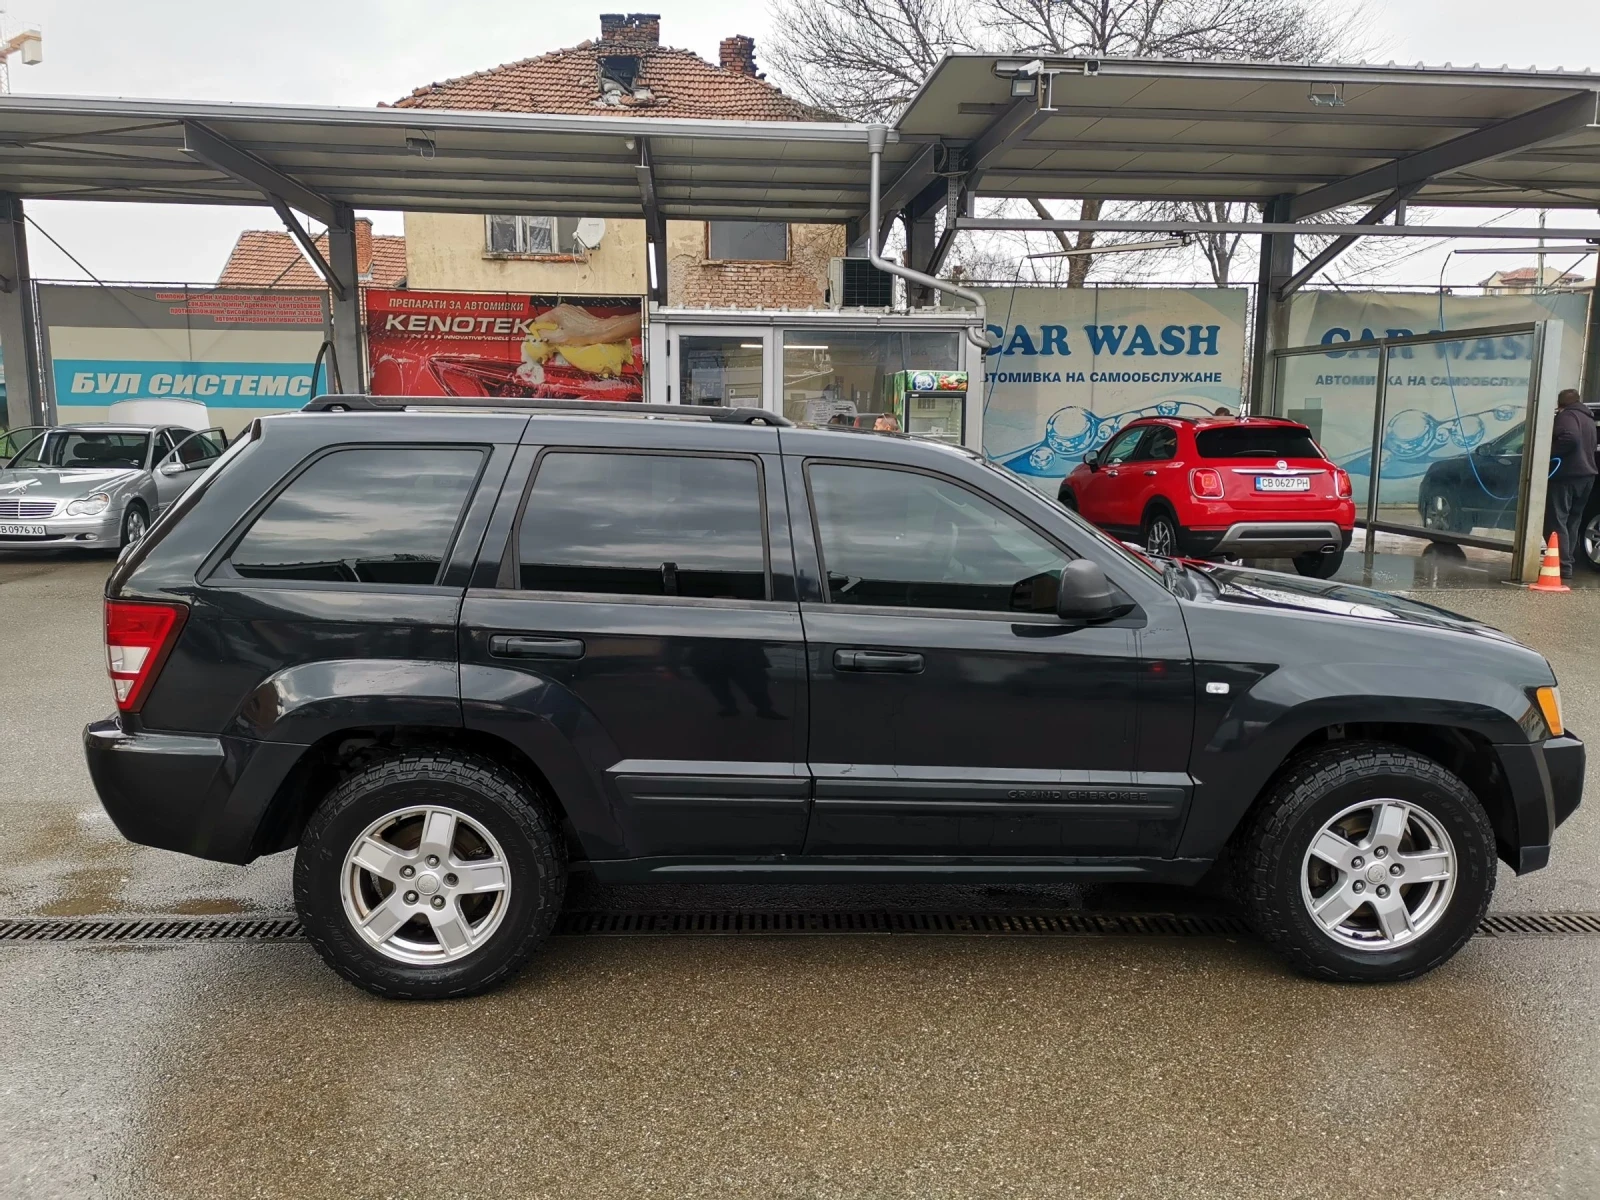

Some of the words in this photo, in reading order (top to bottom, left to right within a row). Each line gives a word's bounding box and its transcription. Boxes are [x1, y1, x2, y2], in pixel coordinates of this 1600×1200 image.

[389, 299, 447, 309] ПРЕПАРАТИ
[449, 301, 462, 309] ЗА
[464, 301, 523, 311] АВТОМИВКИ
[386, 314, 534, 334] KENOTEK
[986, 324, 1071, 355] CAR
[1085, 324, 1221, 356] WASH
[1428, 330, 1533, 361] WAS
[1066, 372, 1085, 382] НА
[1089, 372, 1222, 383] САМООБСЛУЖАНЕ
[1315, 374, 1402, 386] АВТОМИКА
[1407, 376, 1426, 386] НА
[71, 372, 142, 394] БУЛ
[148, 374, 312, 397] СИСТЕМС
[1262, 479, 1274, 488] CB
[1275, 479, 1295, 488] 0627
[1297, 480, 1308, 488] PH
[8, 526, 30, 534] 0976
[1007, 789, 1062, 799] GRAND
[1068, 791, 1149, 801] CHEROKEE
